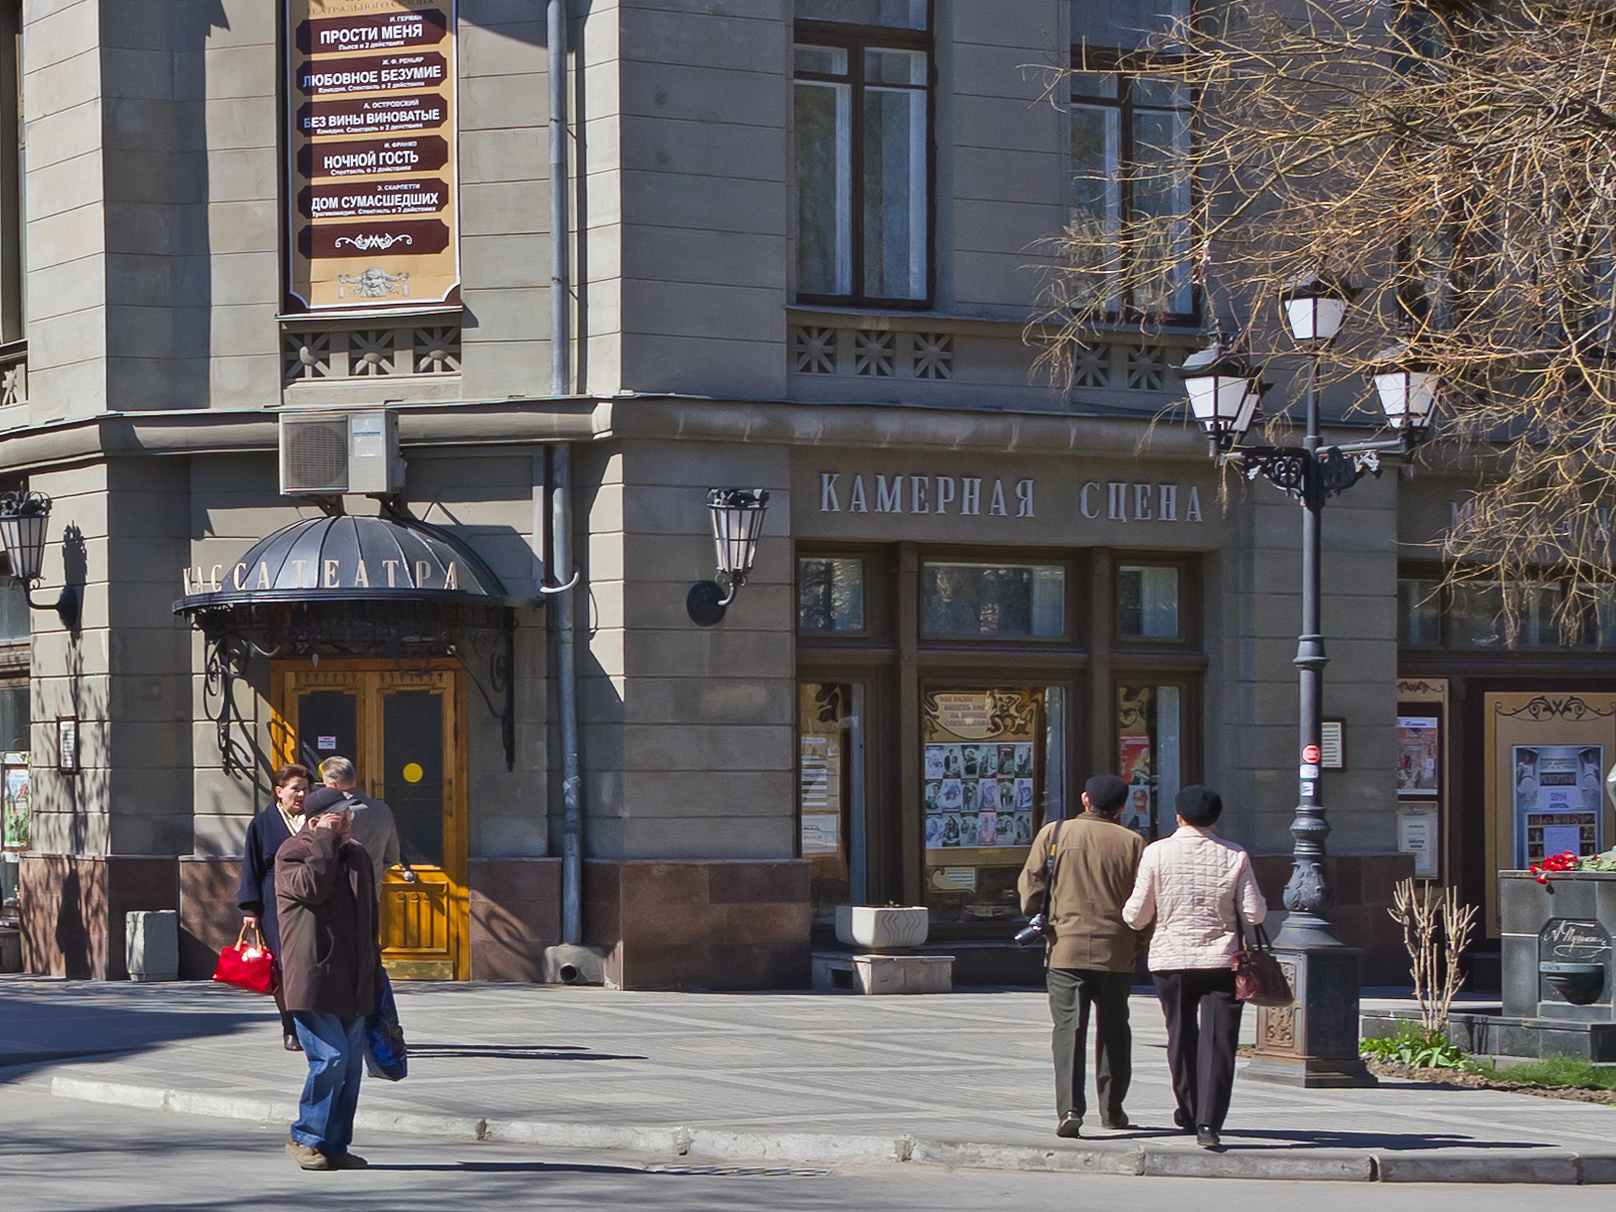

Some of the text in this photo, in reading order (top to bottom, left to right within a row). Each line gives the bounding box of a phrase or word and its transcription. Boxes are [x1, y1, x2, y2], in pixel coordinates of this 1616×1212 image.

[320, 24, 423, 45] ПРОСТИ МЕНЯ
[303, 65, 441, 88] ЛЮБОВНОЕ БЕЗУМИЕ
[303, 109, 441, 129] БЕЗ ВИНЫ ВИНОВАТЫЕ
[323, 150, 419, 169] НОЧНОЙ ГОСТЬ
[311, 192, 439, 212] ДОМ СУМАСШЕДШИХ
[819, 472, 1204, 523] КАМЕРНАЯ СЦЕНА
[182, 558, 459, 597] КАССА ТЕАТРА
